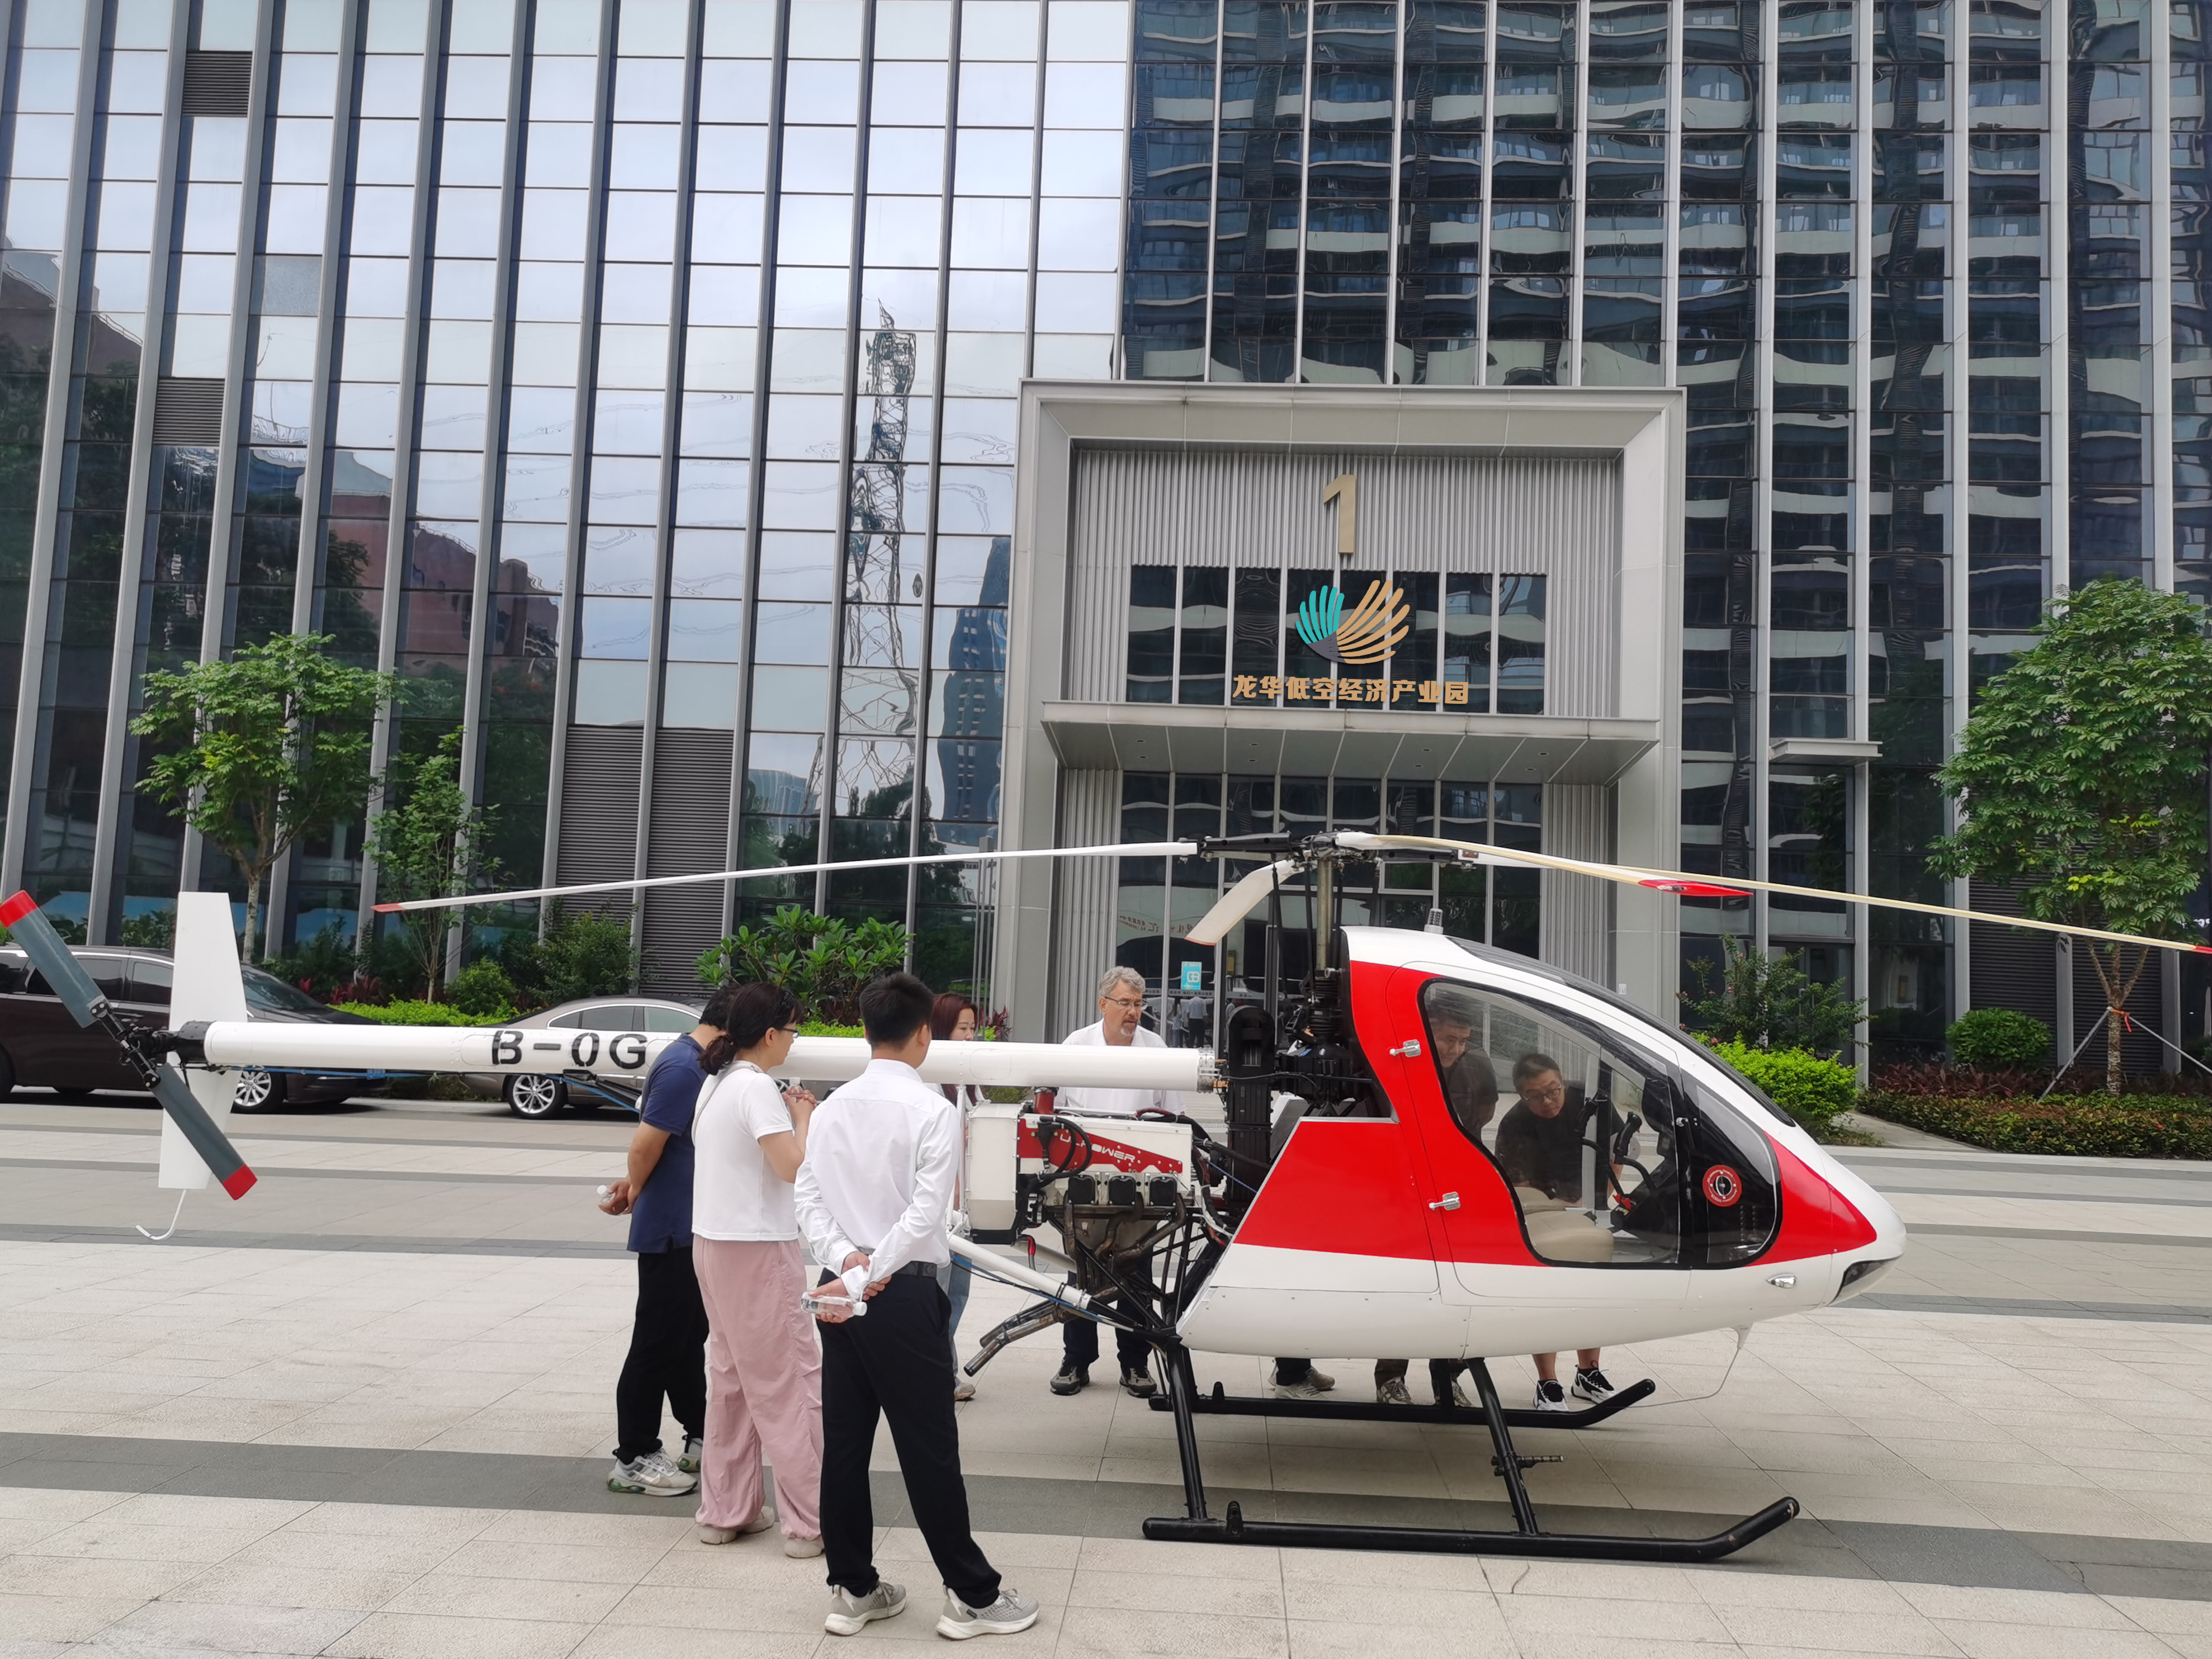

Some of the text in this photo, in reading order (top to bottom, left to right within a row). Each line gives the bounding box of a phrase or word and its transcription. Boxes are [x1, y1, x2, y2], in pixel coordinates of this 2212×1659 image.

[1324, 474, 1357, 555] 1
[1233, 675, 1469, 705] 龙华低空经济产业园
